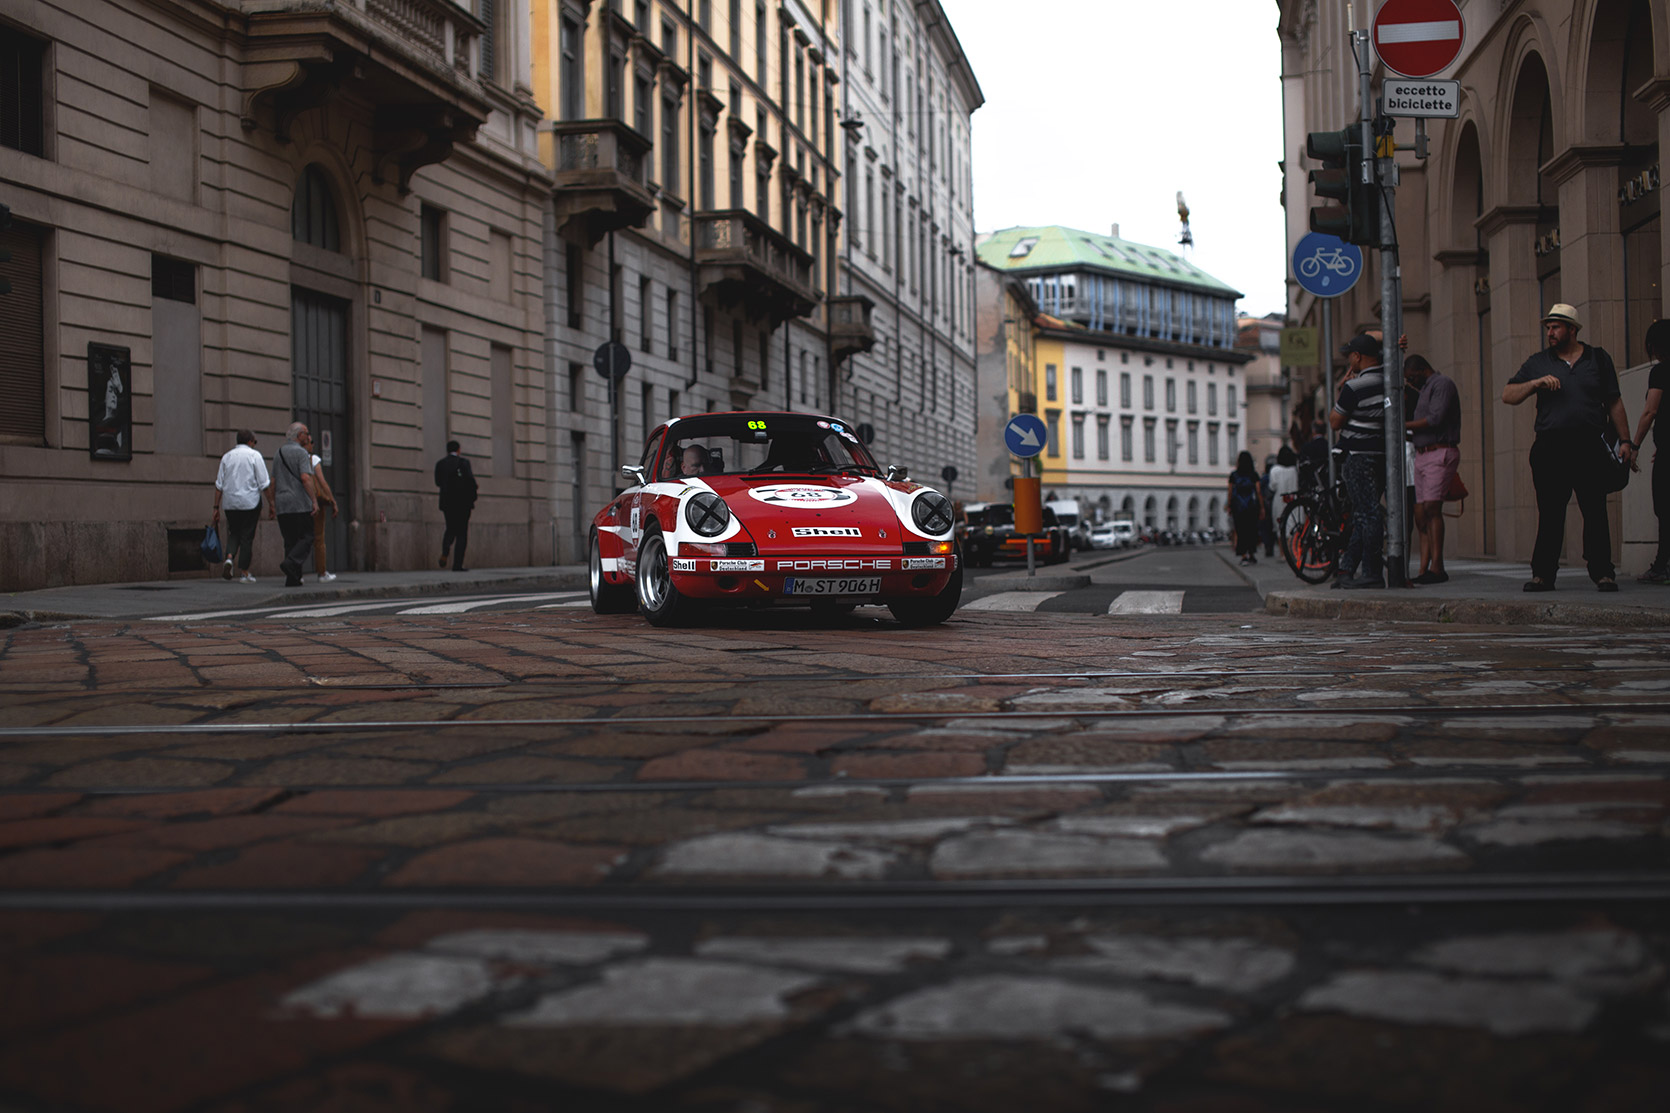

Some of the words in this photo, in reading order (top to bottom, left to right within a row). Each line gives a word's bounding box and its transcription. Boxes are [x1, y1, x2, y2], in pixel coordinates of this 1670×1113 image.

[1395, 85, 1446, 96] eccetto
[1388, 98, 1453, 110] biciclette
[747, 420, 767, 430] 68
[794, 528, 860, 536] Shell
[672, 560, 695, 570] Shell
[777, 560, 892, 571] PORSCHE
